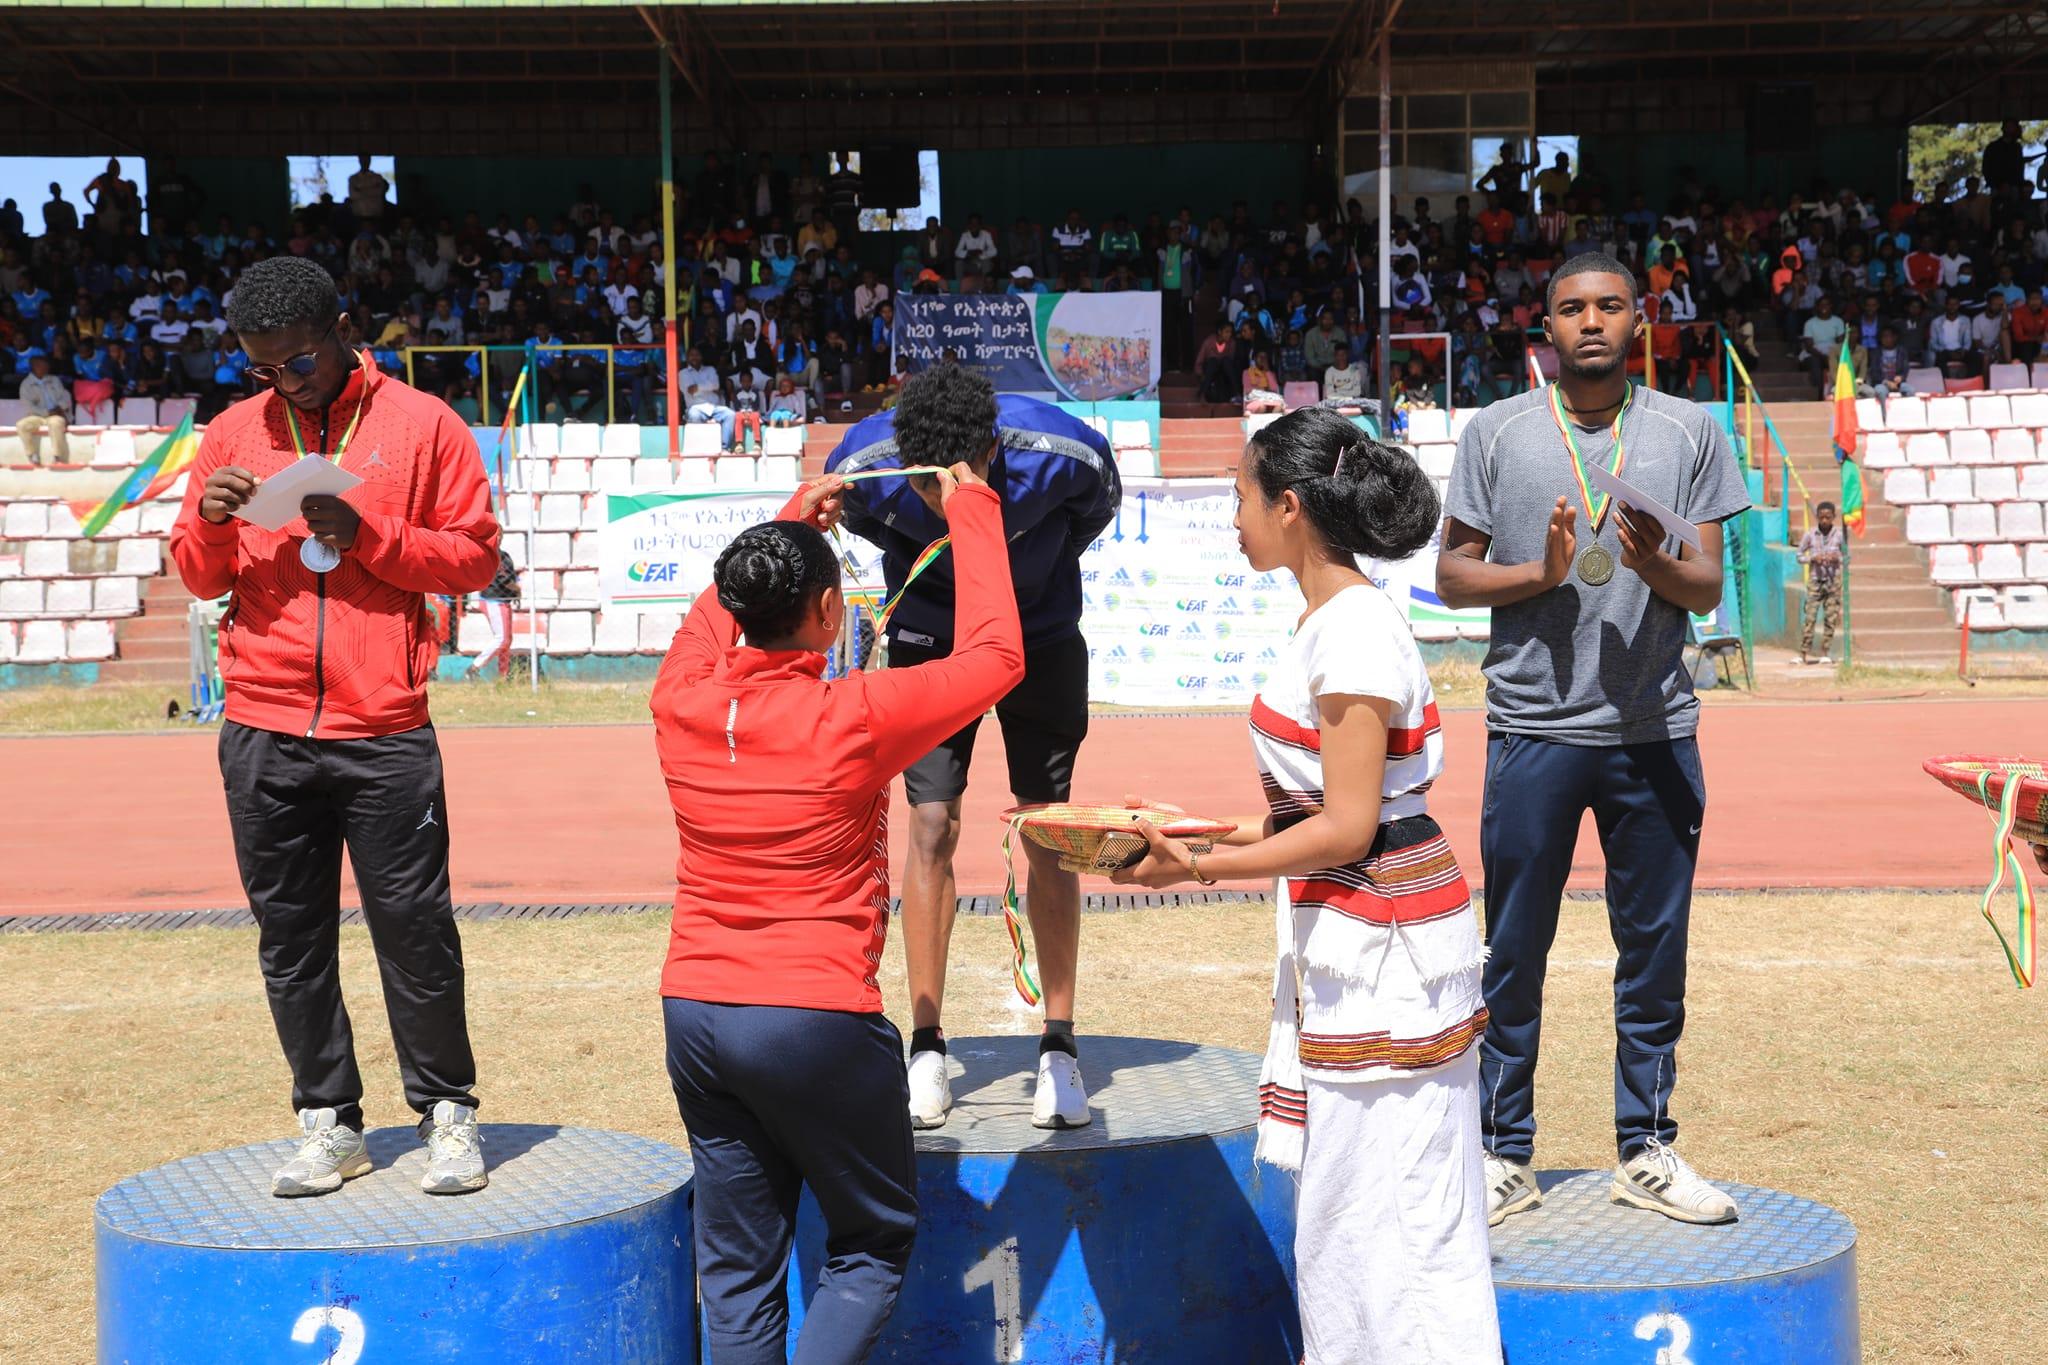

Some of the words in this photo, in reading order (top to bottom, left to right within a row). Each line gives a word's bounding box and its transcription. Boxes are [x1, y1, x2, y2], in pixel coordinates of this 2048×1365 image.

[953, 300, 1025, 317] የኢትዮጵያ
[906, 323, 935, 338] ከ20
[942, 322, 984, 338] ዓመት
[991, 322, 1029, 339] በታች
[974, 343, 1036, 359] ሻምፒዮና
[695, 506, 779, 525] የኢትዮጵ
[643, 563, 679, 582] EAF
[1224, 575, 1246, 587] EAF
[1185, 600, 1208, 612] EAF
[1149, 624, 1171, 636] EAF
[1223, 651, 1246, 663] EAF
[1185, 676, 1209, 688] EAF
[963, 1236, 1023, 1363] 1
[290, 1306, 366, 1365] 2
